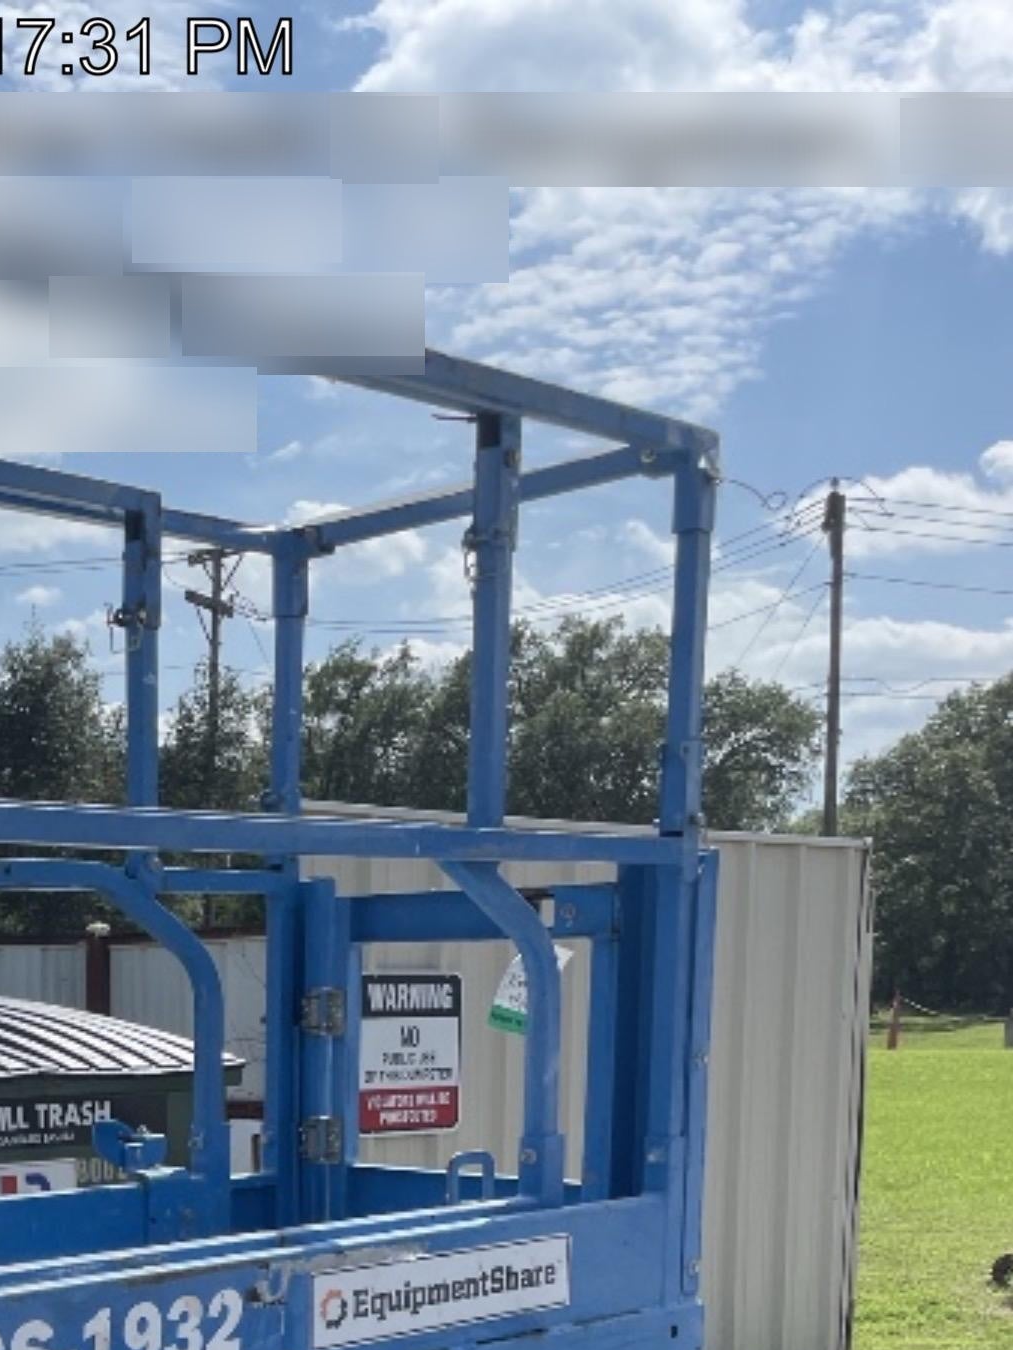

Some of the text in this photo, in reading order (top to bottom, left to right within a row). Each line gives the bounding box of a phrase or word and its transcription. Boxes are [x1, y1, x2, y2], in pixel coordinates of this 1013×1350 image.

[368, 982, 454, 1013] WARNING
[400, 1025, 420, 1048] NO
[35, 1099, 114, 1130] TRASH
[352, 1262, 557, 1322] EquipmentShare
